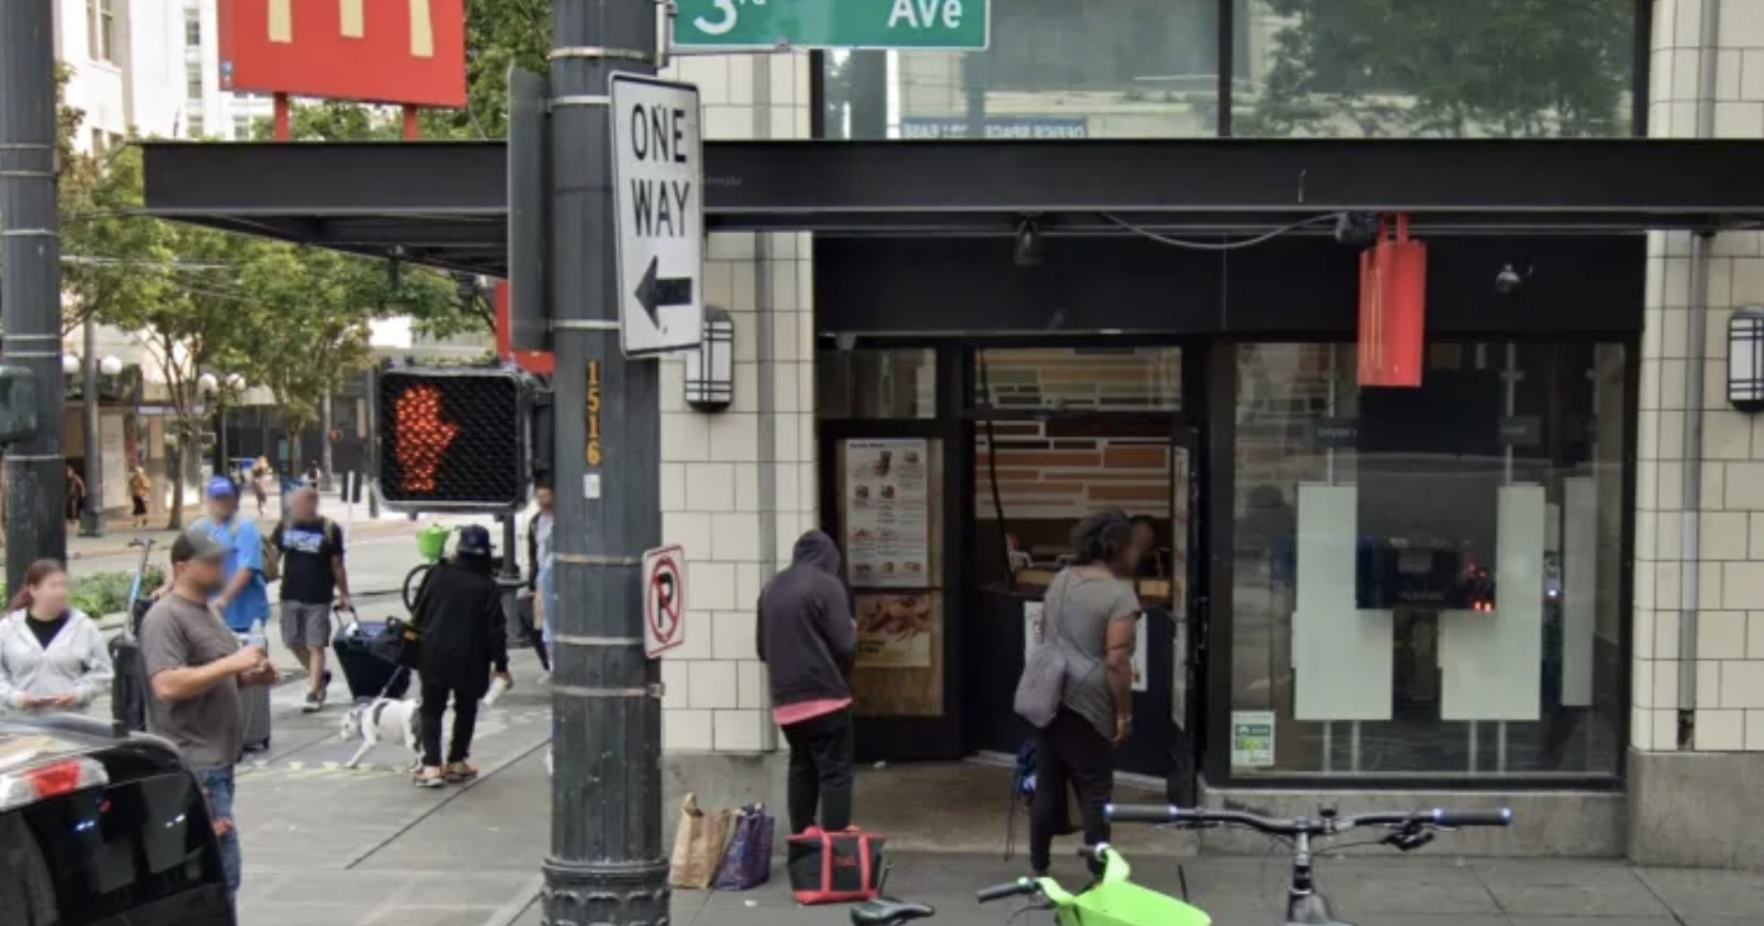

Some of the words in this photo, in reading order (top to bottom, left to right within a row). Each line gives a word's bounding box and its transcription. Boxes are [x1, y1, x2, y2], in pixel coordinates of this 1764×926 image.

[887, 0, 963, 28] Ave
[632, 103, 687, 163] ONE
[631, 179, 690, 238] WAY
[586, 360, 602, 468] 1516
